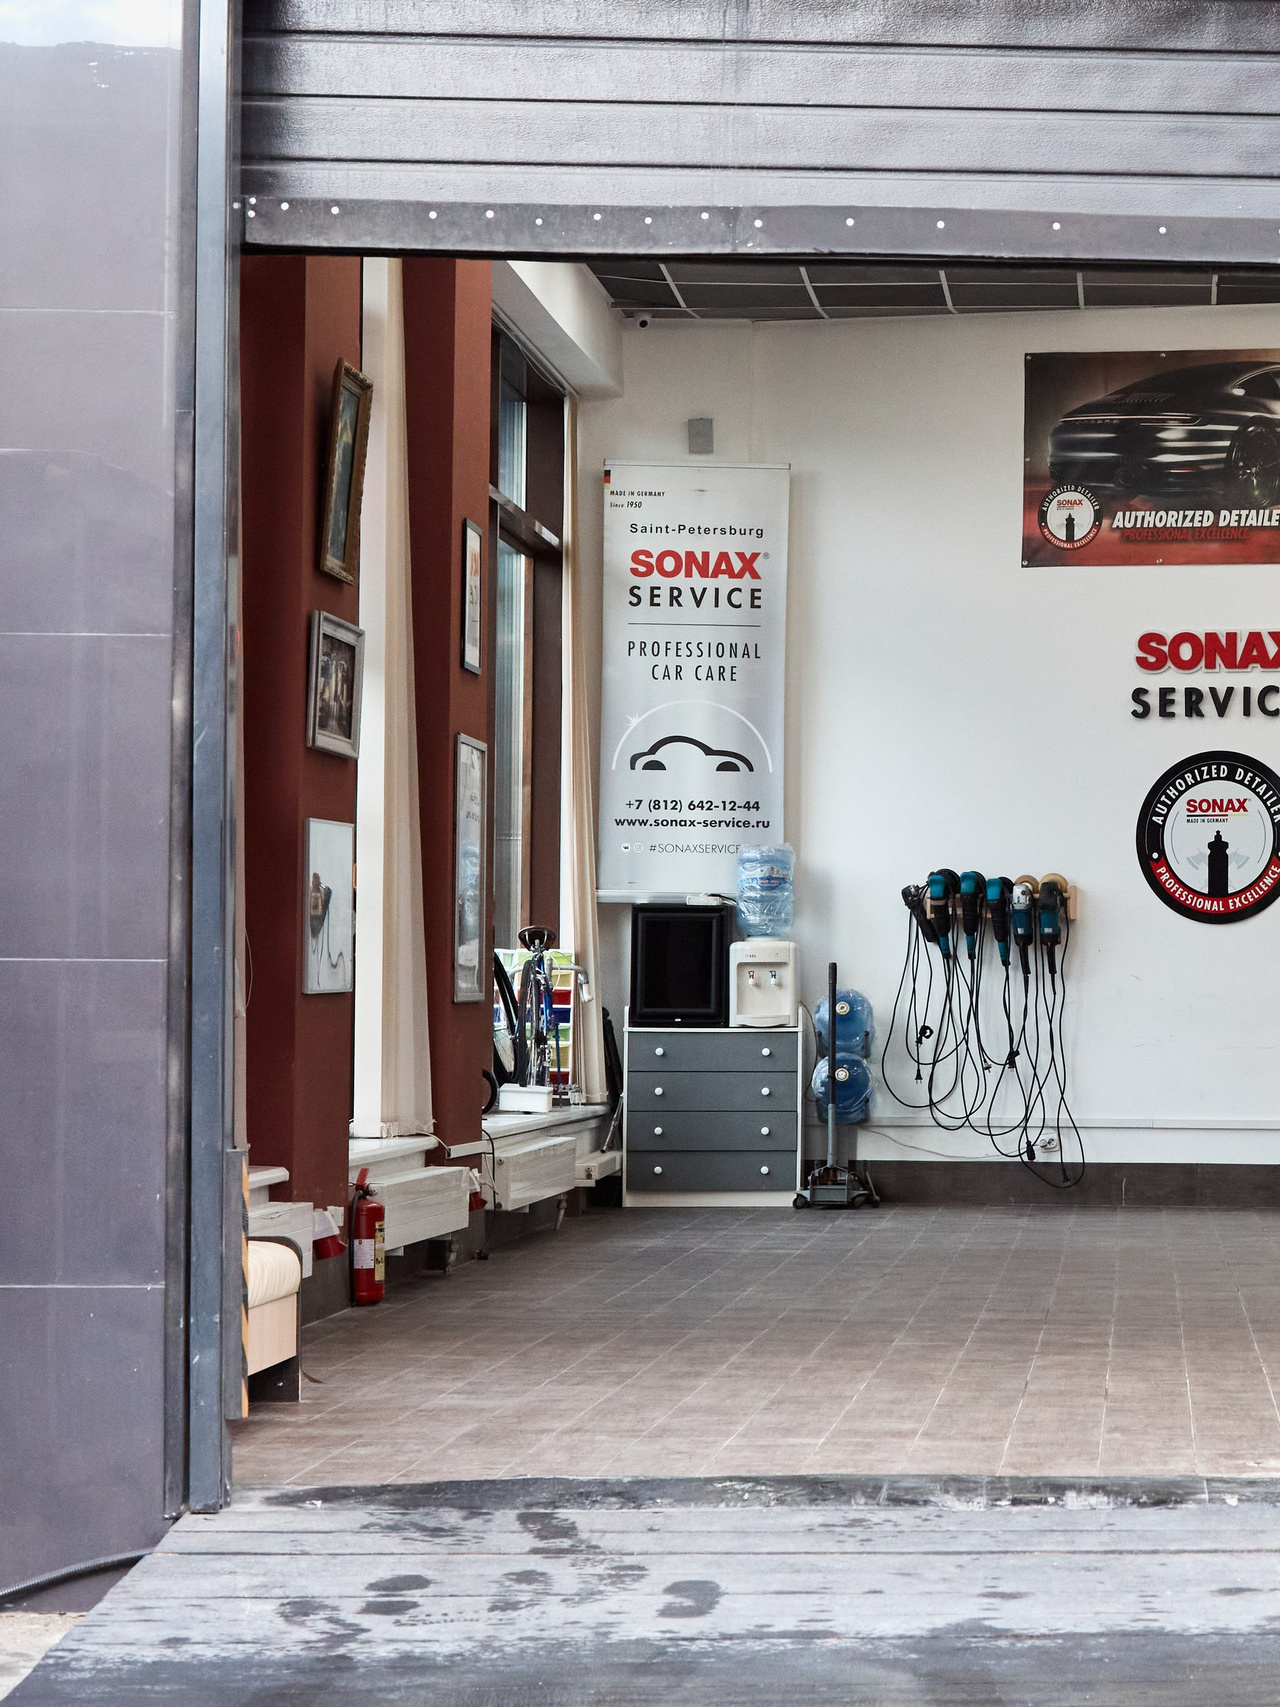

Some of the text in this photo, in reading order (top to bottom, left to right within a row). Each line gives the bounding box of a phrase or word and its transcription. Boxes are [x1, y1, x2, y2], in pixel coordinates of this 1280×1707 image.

[1042, 485, 1100, 512] AUTHORIZED DETAILER
[1112, 510, 1214, 528] AUTHORIZED
[630, 523, 764, 539] Saint-Petersburg
[1043, 528, 1073, 548] PROFESSIONAL
[1124, 528, 1248, 540] PROFESSIONAL EXCELLENCE
[628, 586, 762, 609] SERVICE
[628, 640, 762, 659] PROFESSIONAL
[651, 664, 738, 682] CAR CARE
[1152, 764, 1228, 825] AUTHORIZED
[626, 799, 760, 813] +7 (812) 642-12-44
[1186, 798, 1248, 814] SONAX
[614, 816, 770, 830] www.sonax-service.ru
[649, 843, 742, 854] #SONAXSERVICE
[1156, 866, 1225, 912] PROFESSIONAL
